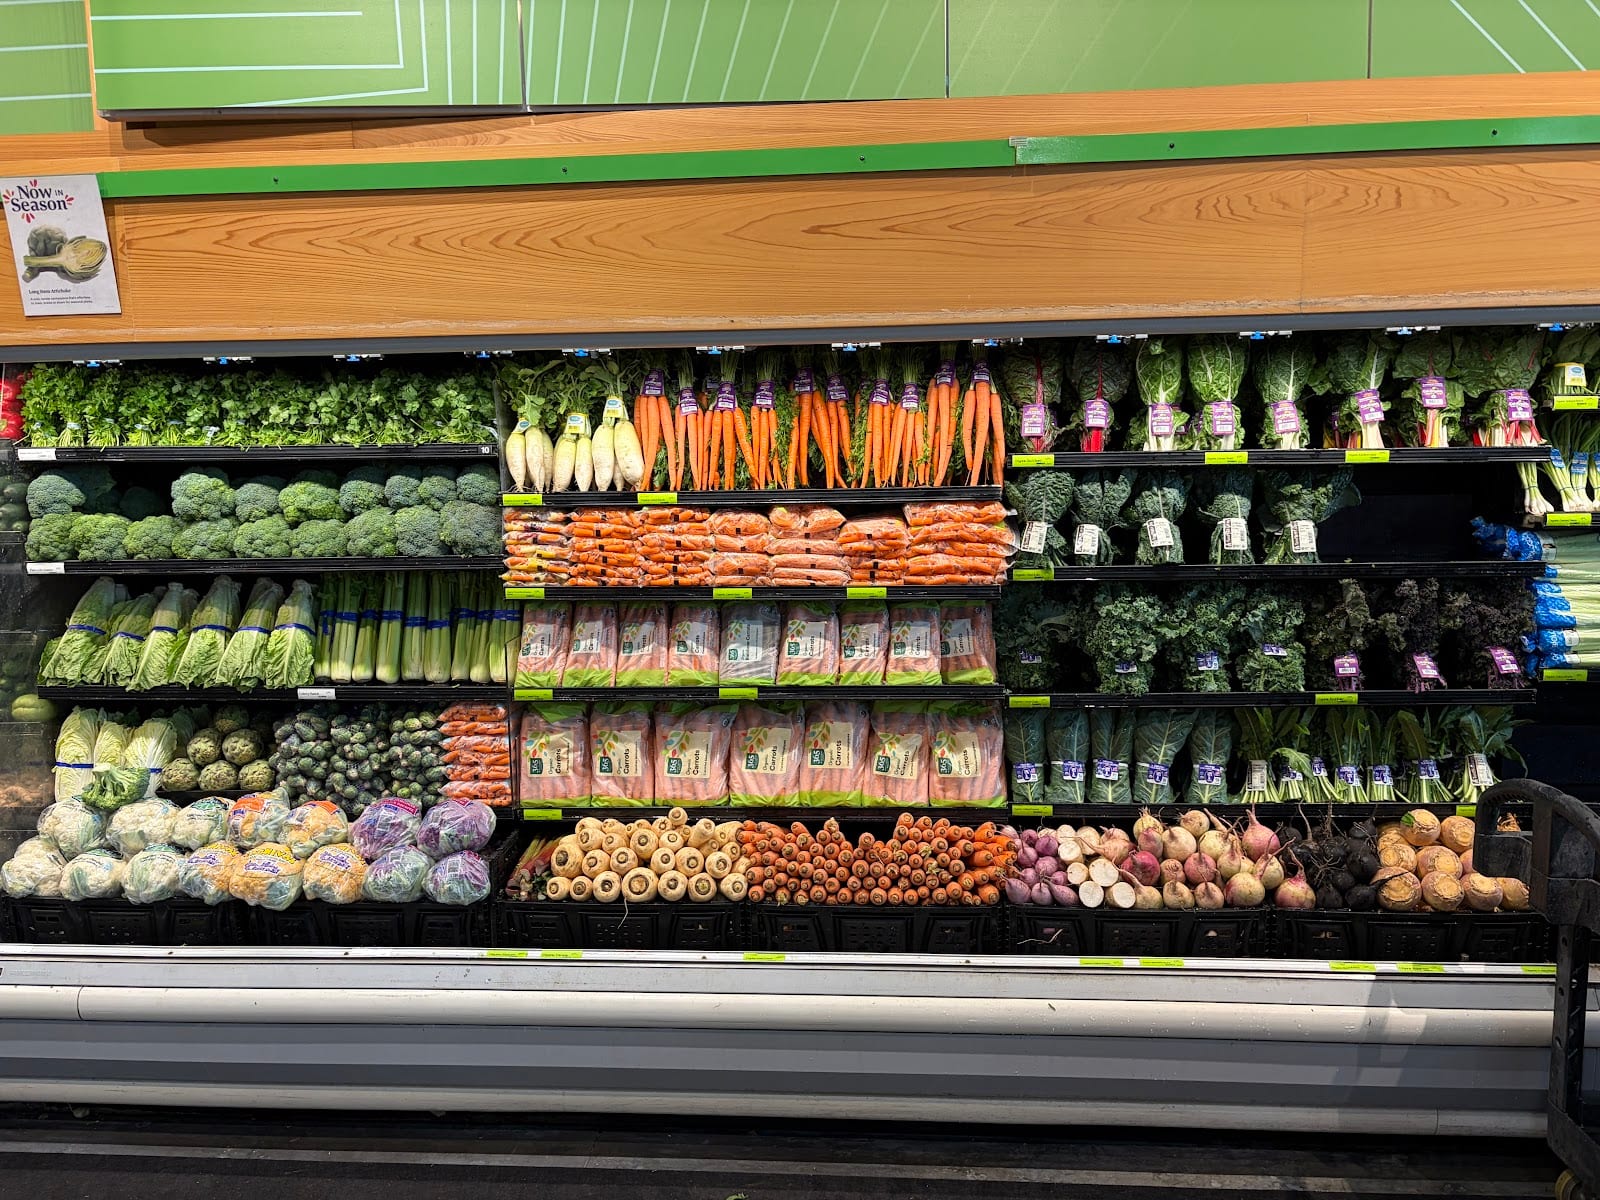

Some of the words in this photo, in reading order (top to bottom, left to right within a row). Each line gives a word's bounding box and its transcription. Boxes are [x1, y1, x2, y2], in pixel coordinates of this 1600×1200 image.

[16, 185, 52, 199] Now
[10, 197, 68, 212] Season
[481, 446, 490, 454] 10
[601, 757, 609, 771] 365
[692, 750, 700, 776] Carrots
[747, 754, 755, 768] 365
[769, 745, 778, 772] Carrots
[812, 750, 821, 764] 365
[877, 757, 885, 771] 365
[900, 750, 910, 776] Carrots
[531, 759, 539, 774] 365
[669, 759, 678, 773] 365
